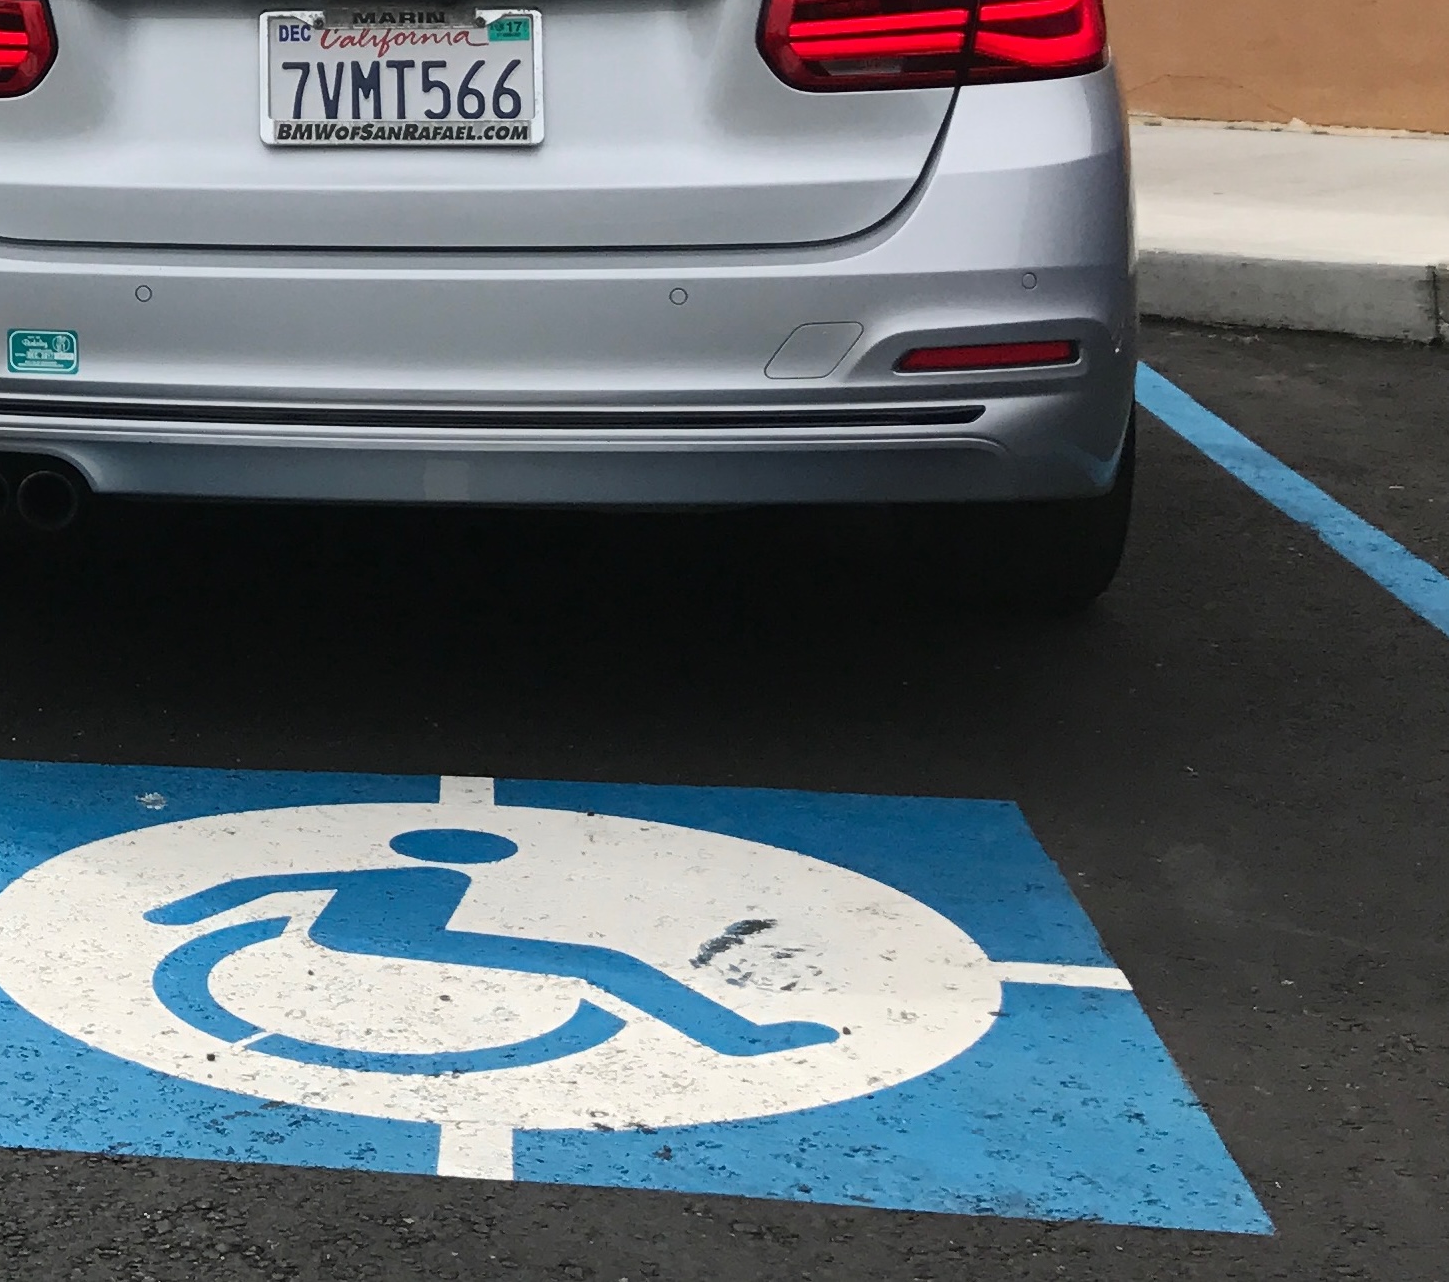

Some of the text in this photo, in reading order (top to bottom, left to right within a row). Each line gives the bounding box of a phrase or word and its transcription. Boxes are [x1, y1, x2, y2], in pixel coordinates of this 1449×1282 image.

[352, 11, 445, 25] MARIN
[278, 24, 311, 42] DEC
[319, 27, 489, 58] California
[281, 59, 521, 120] 7VMT566
